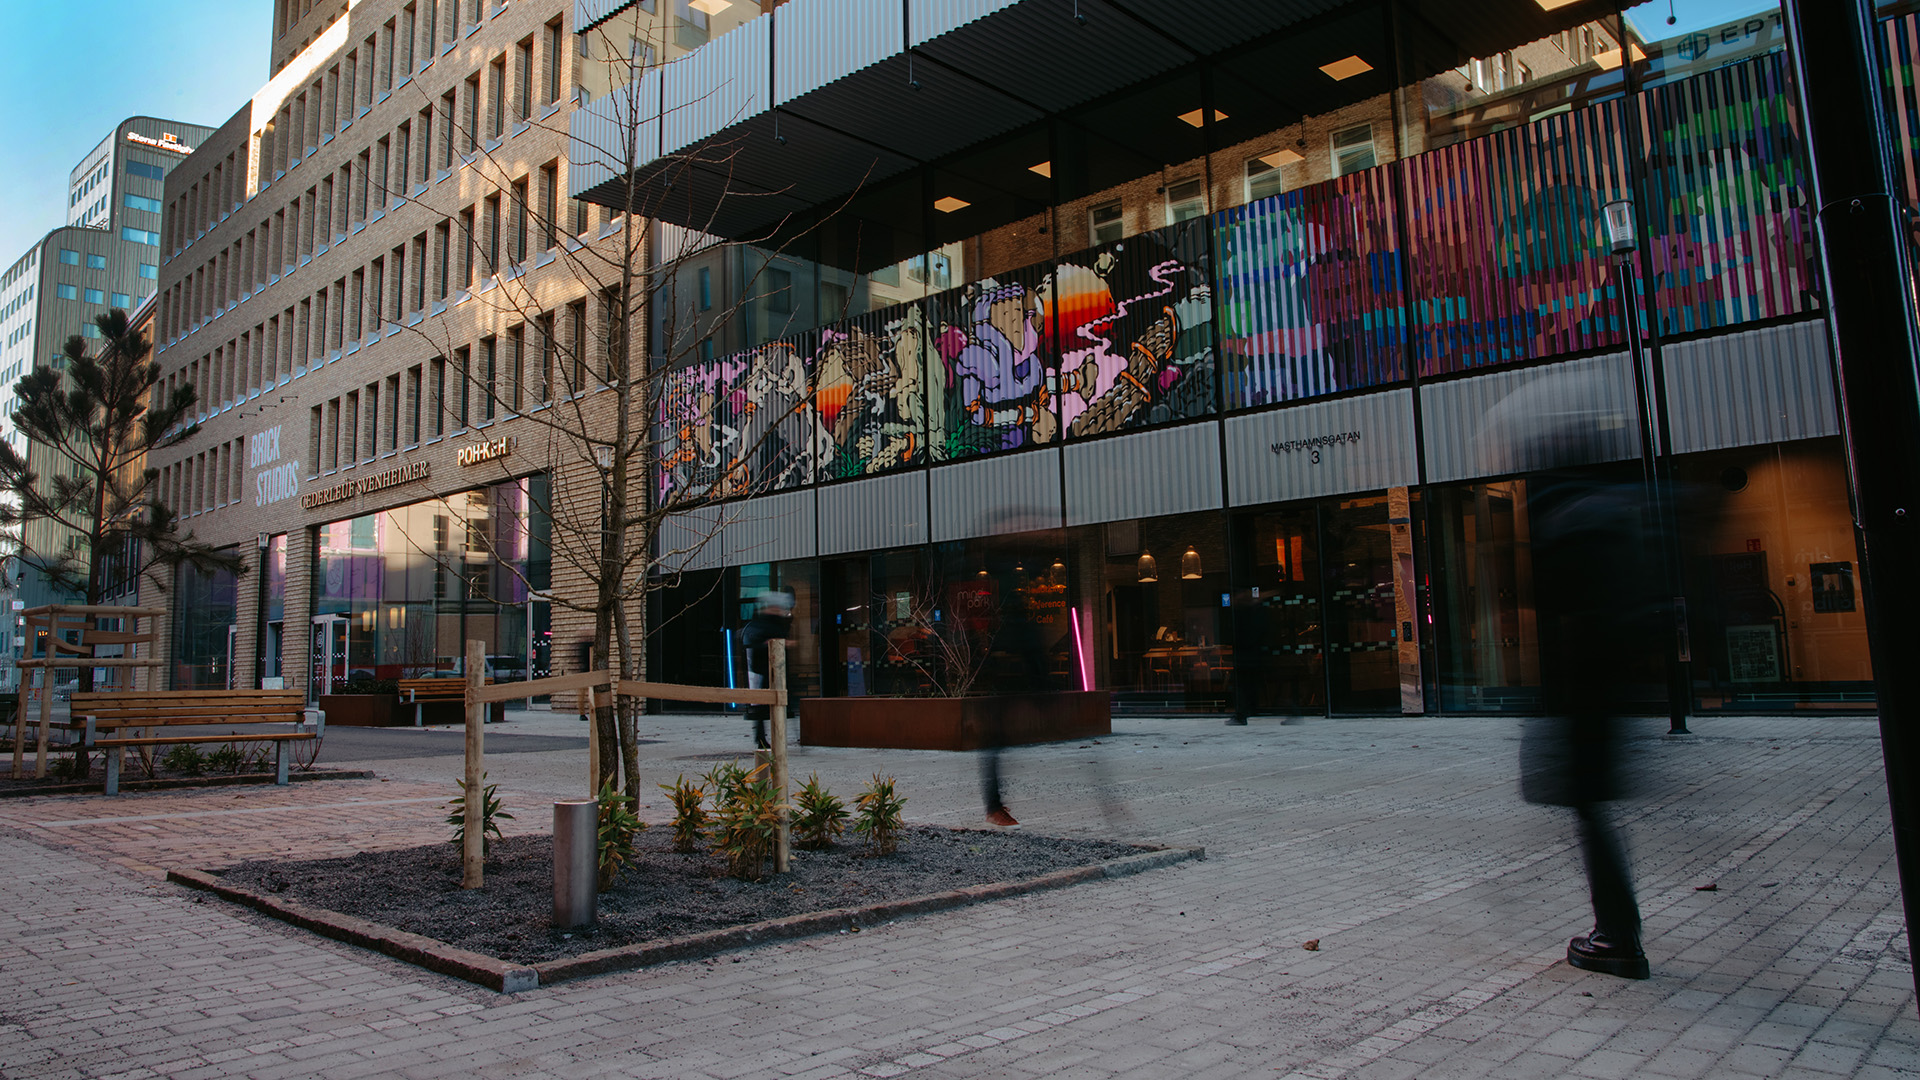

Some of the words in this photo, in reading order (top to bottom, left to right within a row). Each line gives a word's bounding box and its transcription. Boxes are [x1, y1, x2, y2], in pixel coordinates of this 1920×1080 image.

[250, 425, 282, 469] BRICK
[1271, 430, 1361, 453] MASTHAMNSGATAN
[1311, 450, 1321, 464] 3
[255, 460, 300, 507] STUDIOS
[356, 460, 428, 495] SVENHEIMER
[967, 595, 990, 611] park
